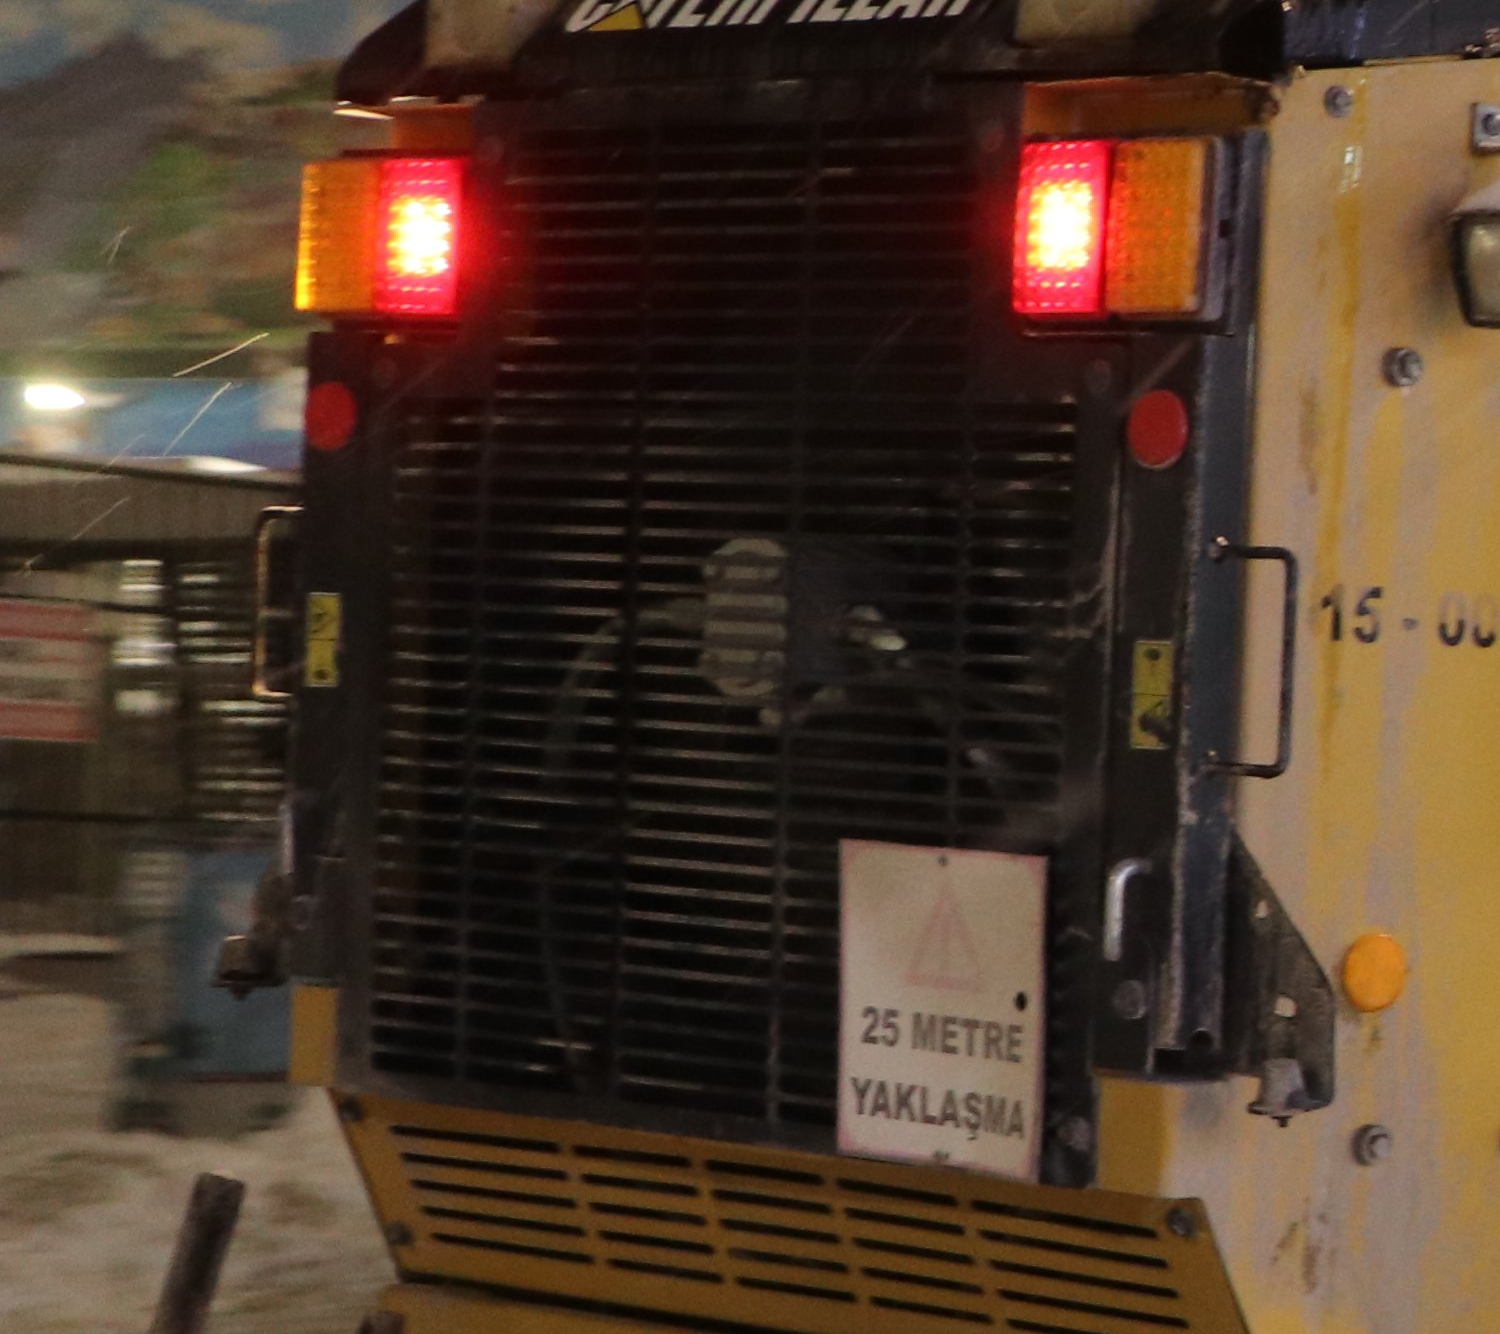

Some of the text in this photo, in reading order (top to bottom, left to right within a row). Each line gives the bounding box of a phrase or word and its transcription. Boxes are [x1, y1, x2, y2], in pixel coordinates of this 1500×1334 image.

[861, 1005, 1025, 1063] 25 METRE
[850, 1077, 1026, 1140] YAKLAŞMA
